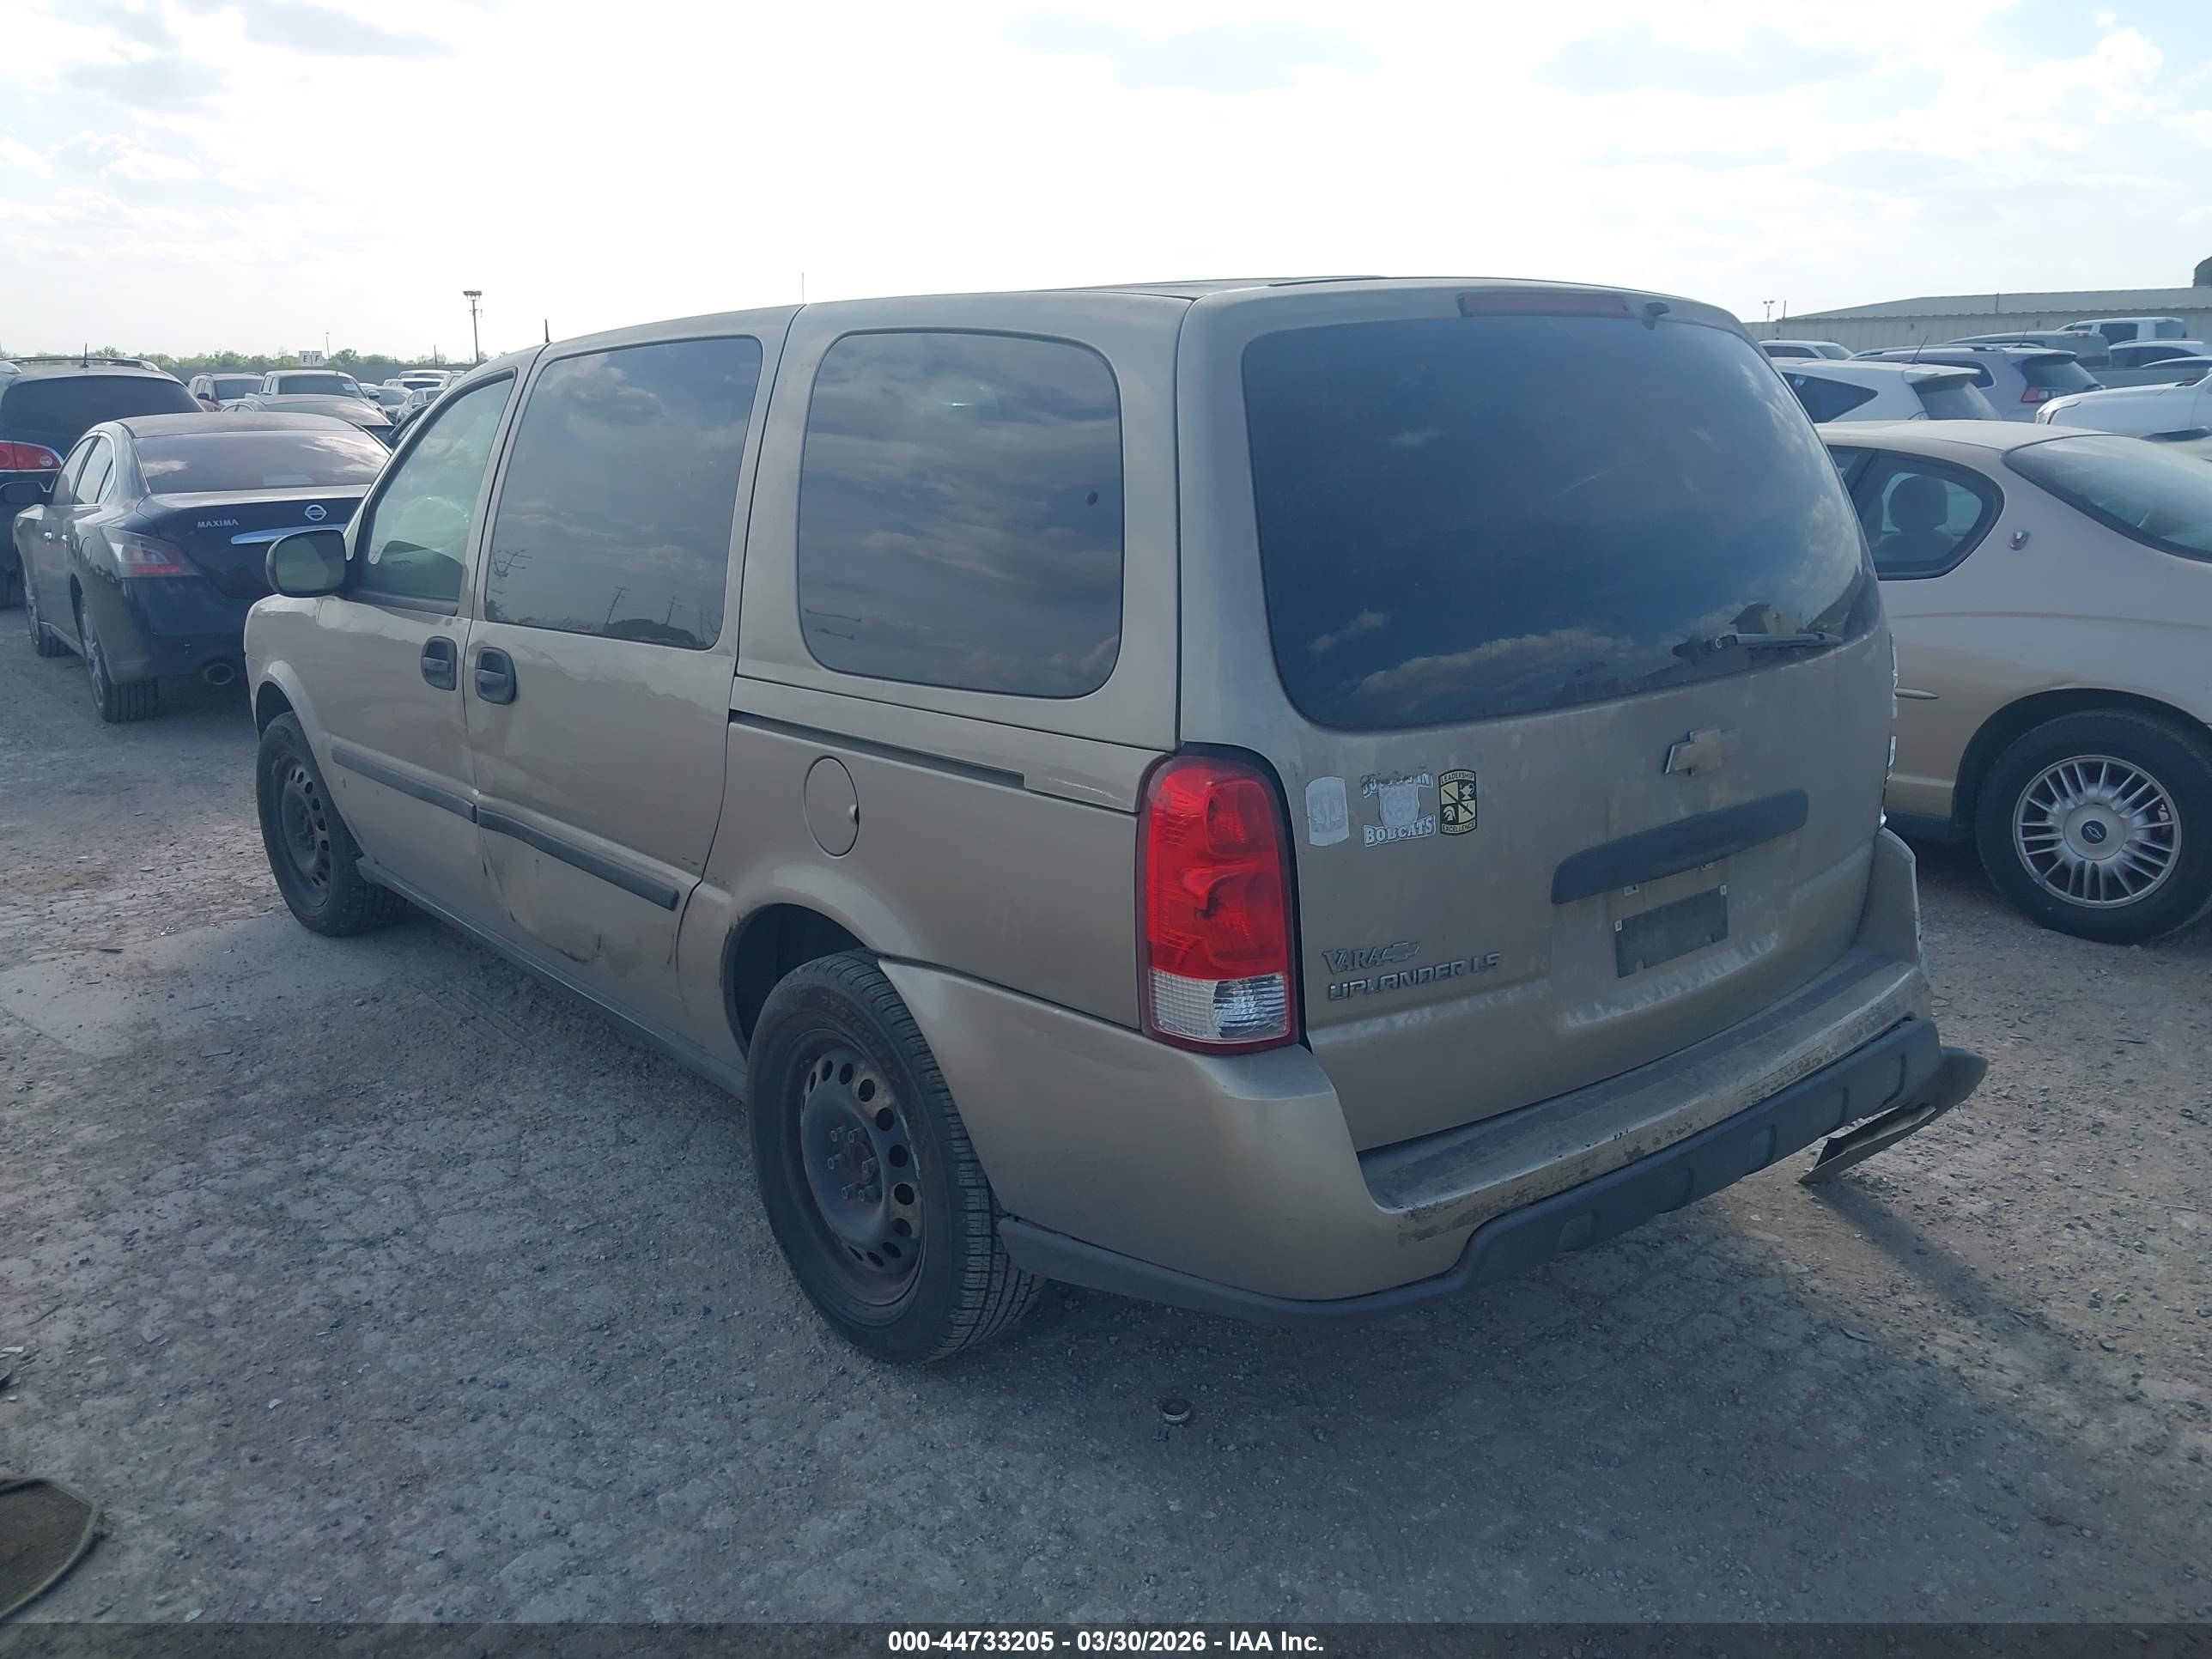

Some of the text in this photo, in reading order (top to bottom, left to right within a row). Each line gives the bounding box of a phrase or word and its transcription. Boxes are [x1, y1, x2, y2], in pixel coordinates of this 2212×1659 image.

[198, 519, 239, 528] MAXIMA
[1440, 772, 1474, 784] LEADERSHIP
[1364, 817, 1433, 843] BOBCATS
[1443, 822, 1475, 832] EXCELLENCE
[1328, 953, 1501, 1001] UPLANDER LS
